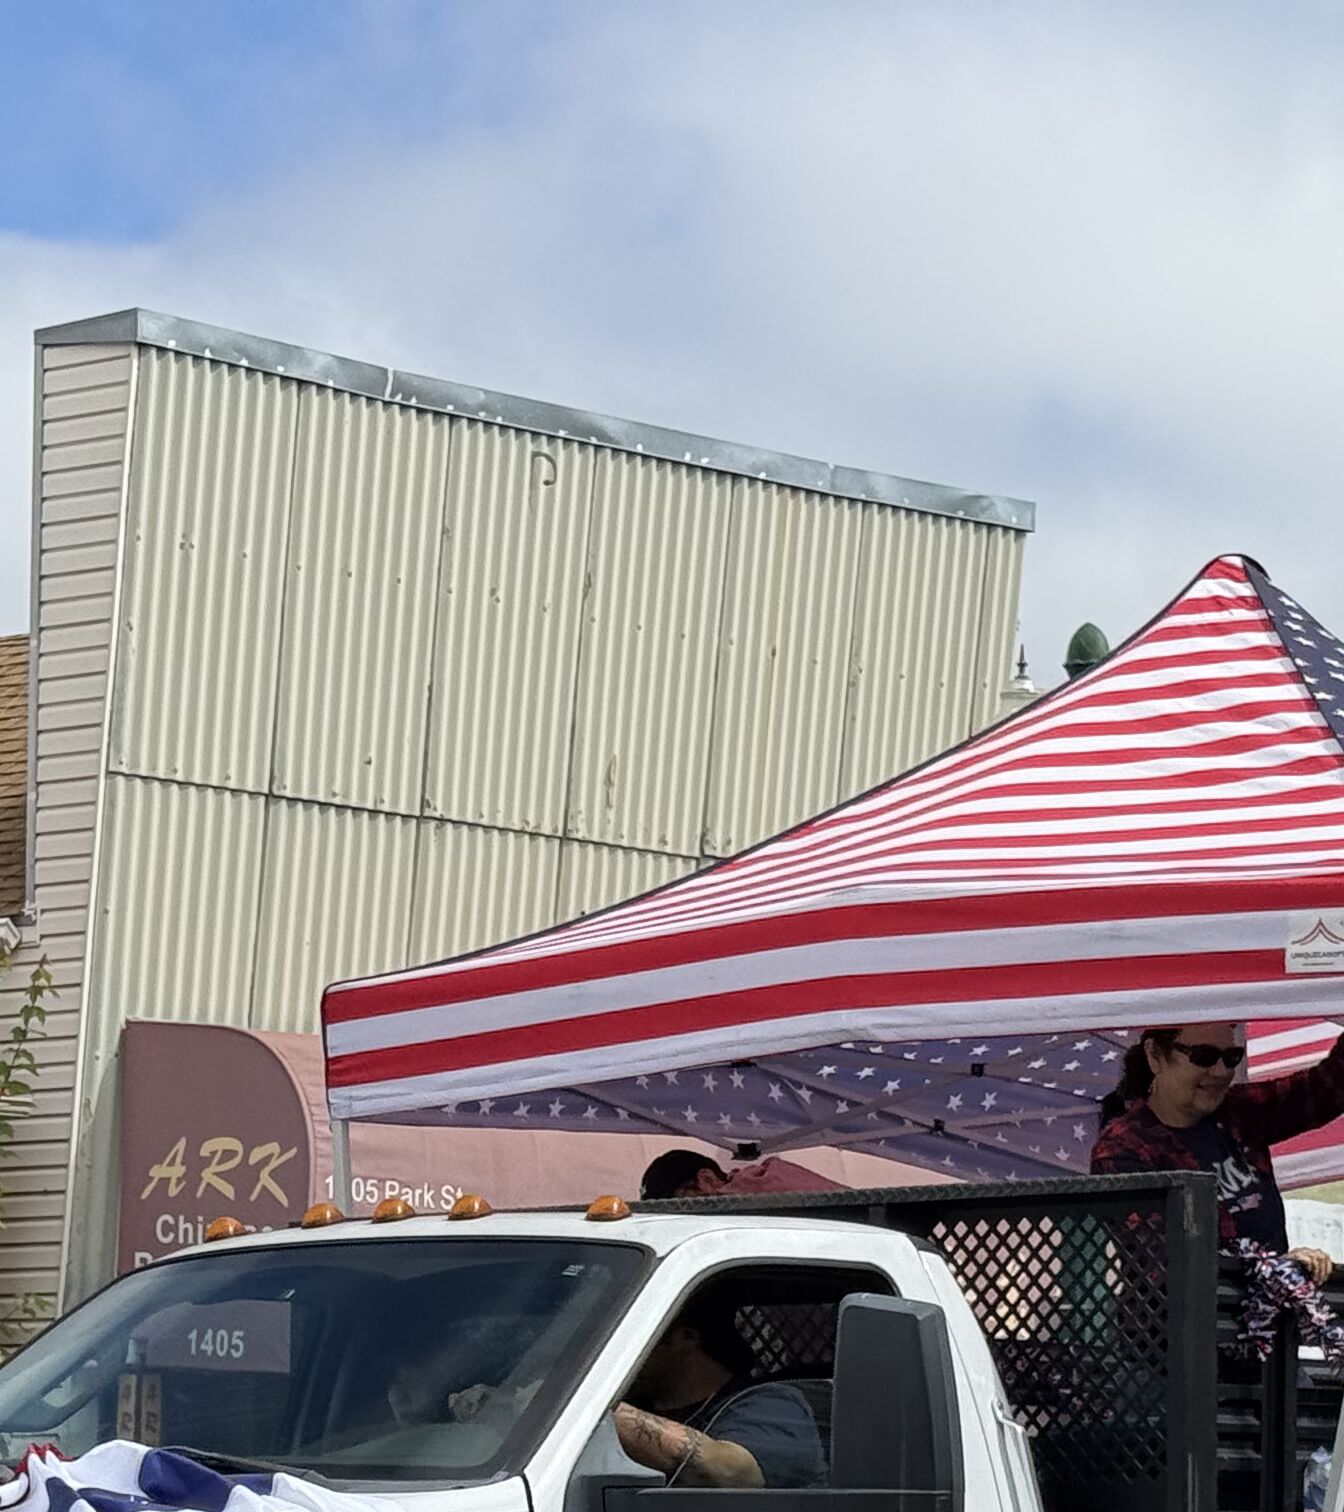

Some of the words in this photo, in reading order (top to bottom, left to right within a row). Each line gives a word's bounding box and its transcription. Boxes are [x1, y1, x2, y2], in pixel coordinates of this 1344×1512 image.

[140, 1136, 298, 1208] ARK
[324, 1175, 379, 1204] 105
[385, 1181, 436, 1209] Park
[187, 1327, 245, 1358] 1405
